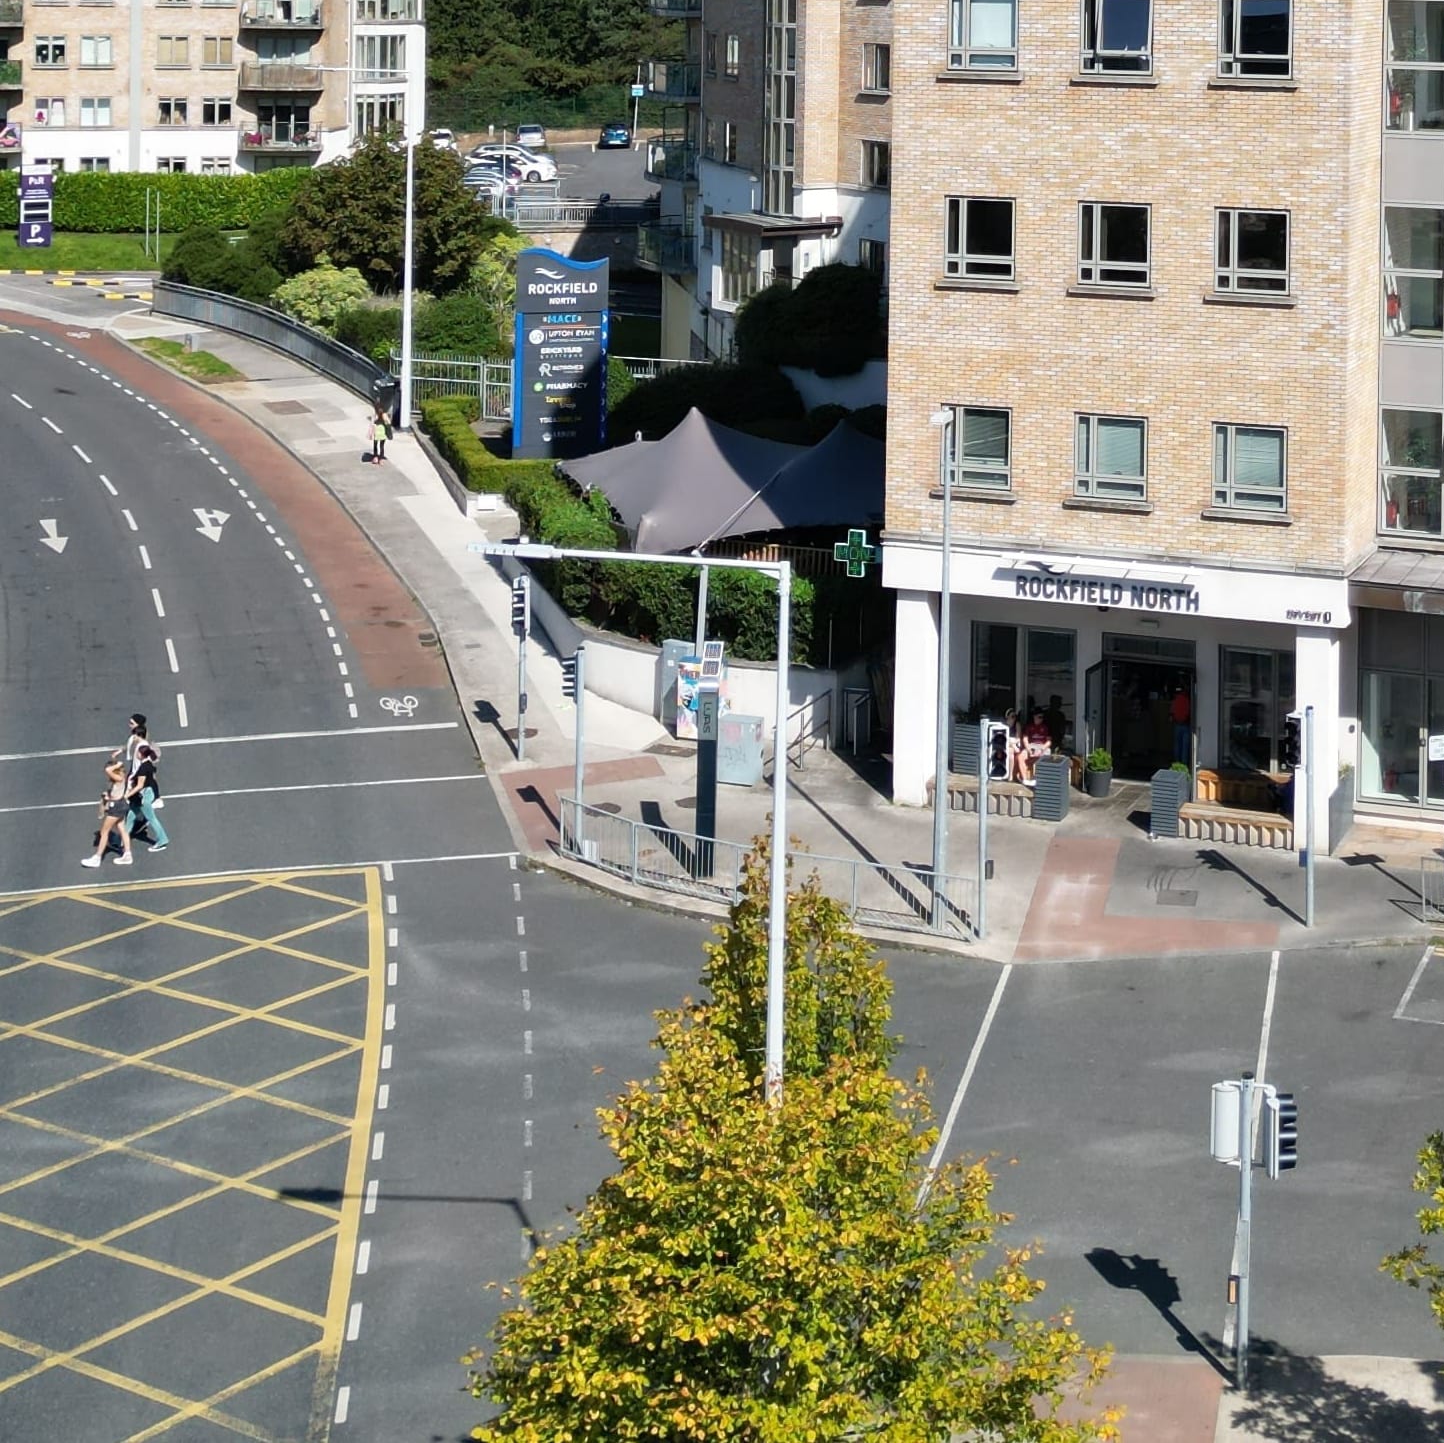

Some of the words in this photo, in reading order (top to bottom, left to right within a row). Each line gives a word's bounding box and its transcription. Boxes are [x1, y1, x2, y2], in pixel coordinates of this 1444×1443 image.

[31, 225, 41, 238] P
[528, 282, 598, 295] ROCKFIELD
[549, 297, 577, 305] NORTH
[547, 315, 578, 324] MACE
[548, 330, 573, 338] UPTON
[546, 382, 588, 390] PHARMACY
[1016, 575, 1123, 606] ROCKFIELD
[1131, 585, 1200, 613] NORTH
